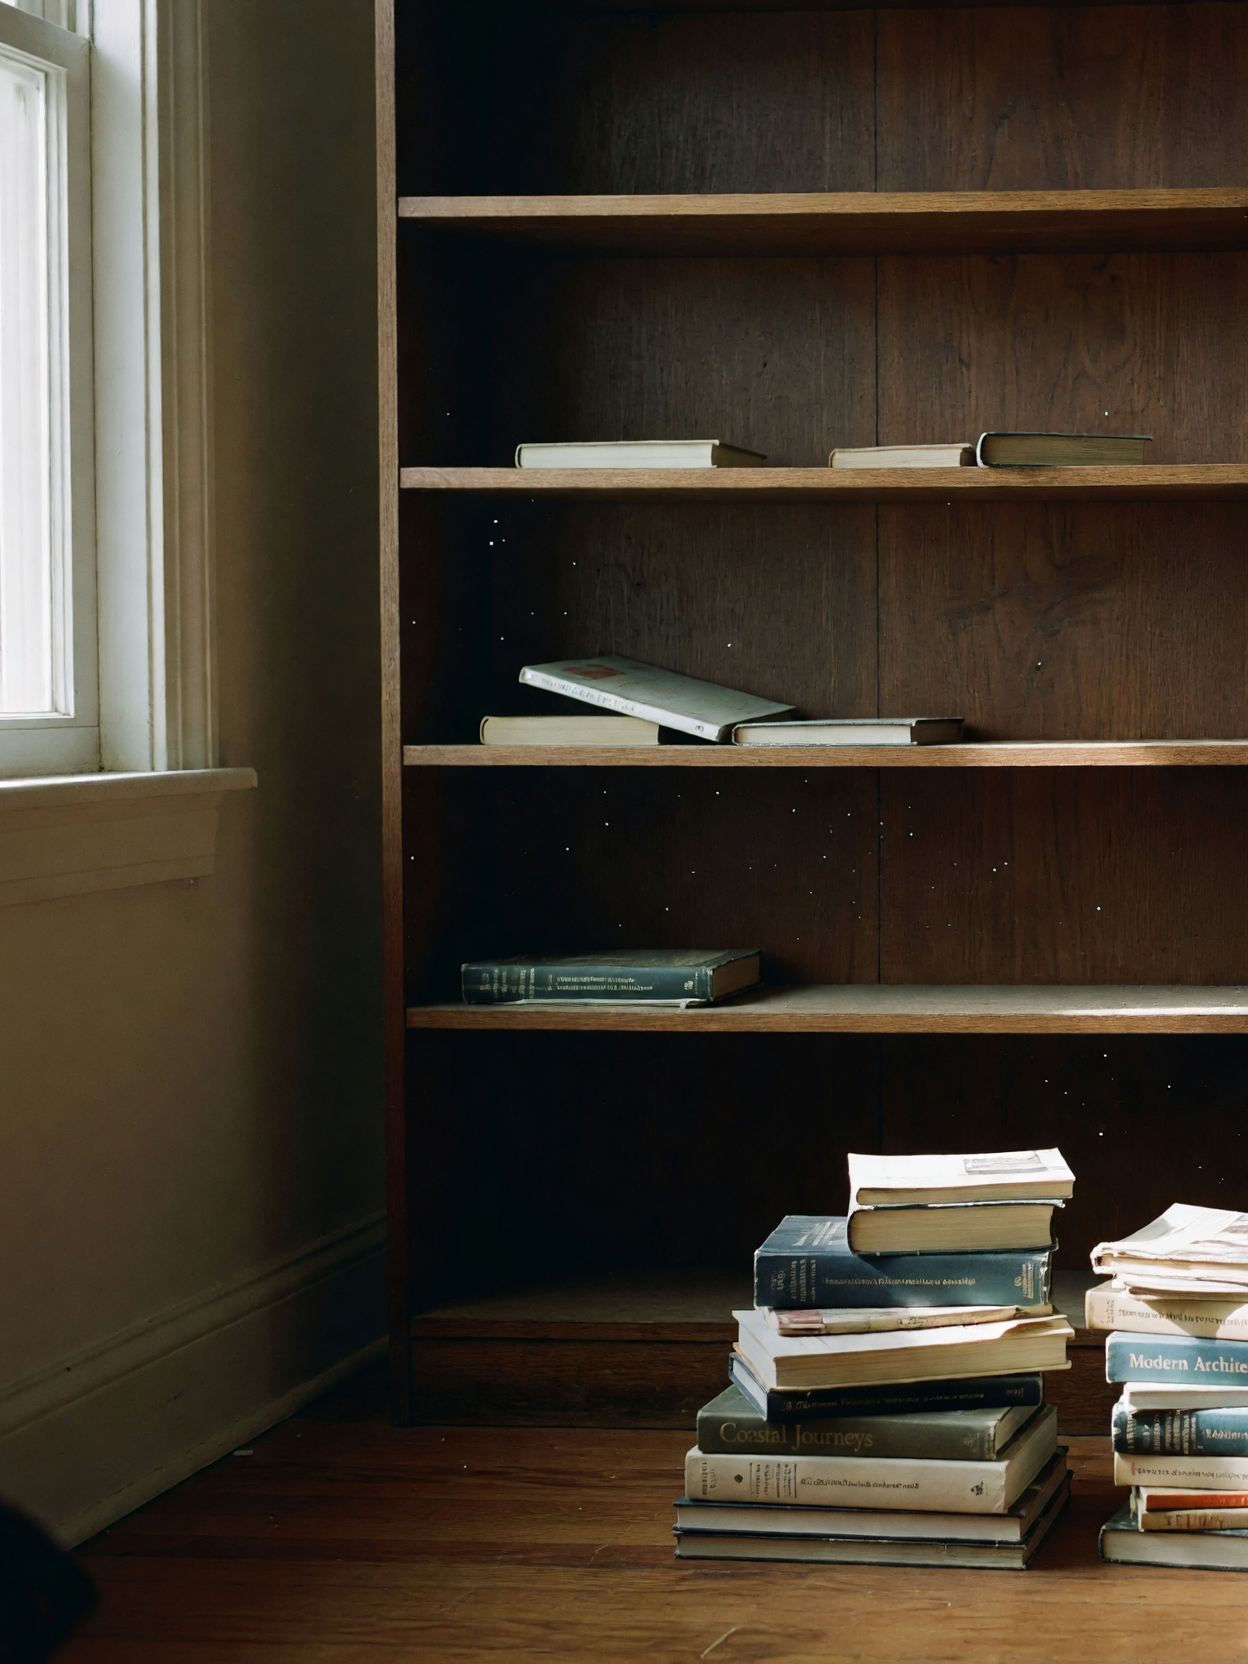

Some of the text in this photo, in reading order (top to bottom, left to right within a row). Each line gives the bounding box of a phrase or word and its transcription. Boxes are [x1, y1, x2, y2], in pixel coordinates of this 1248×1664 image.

[1129, 1353, 1188, 1371] Modern
[719, 1422, 873, 1452] Coastal Journeys
